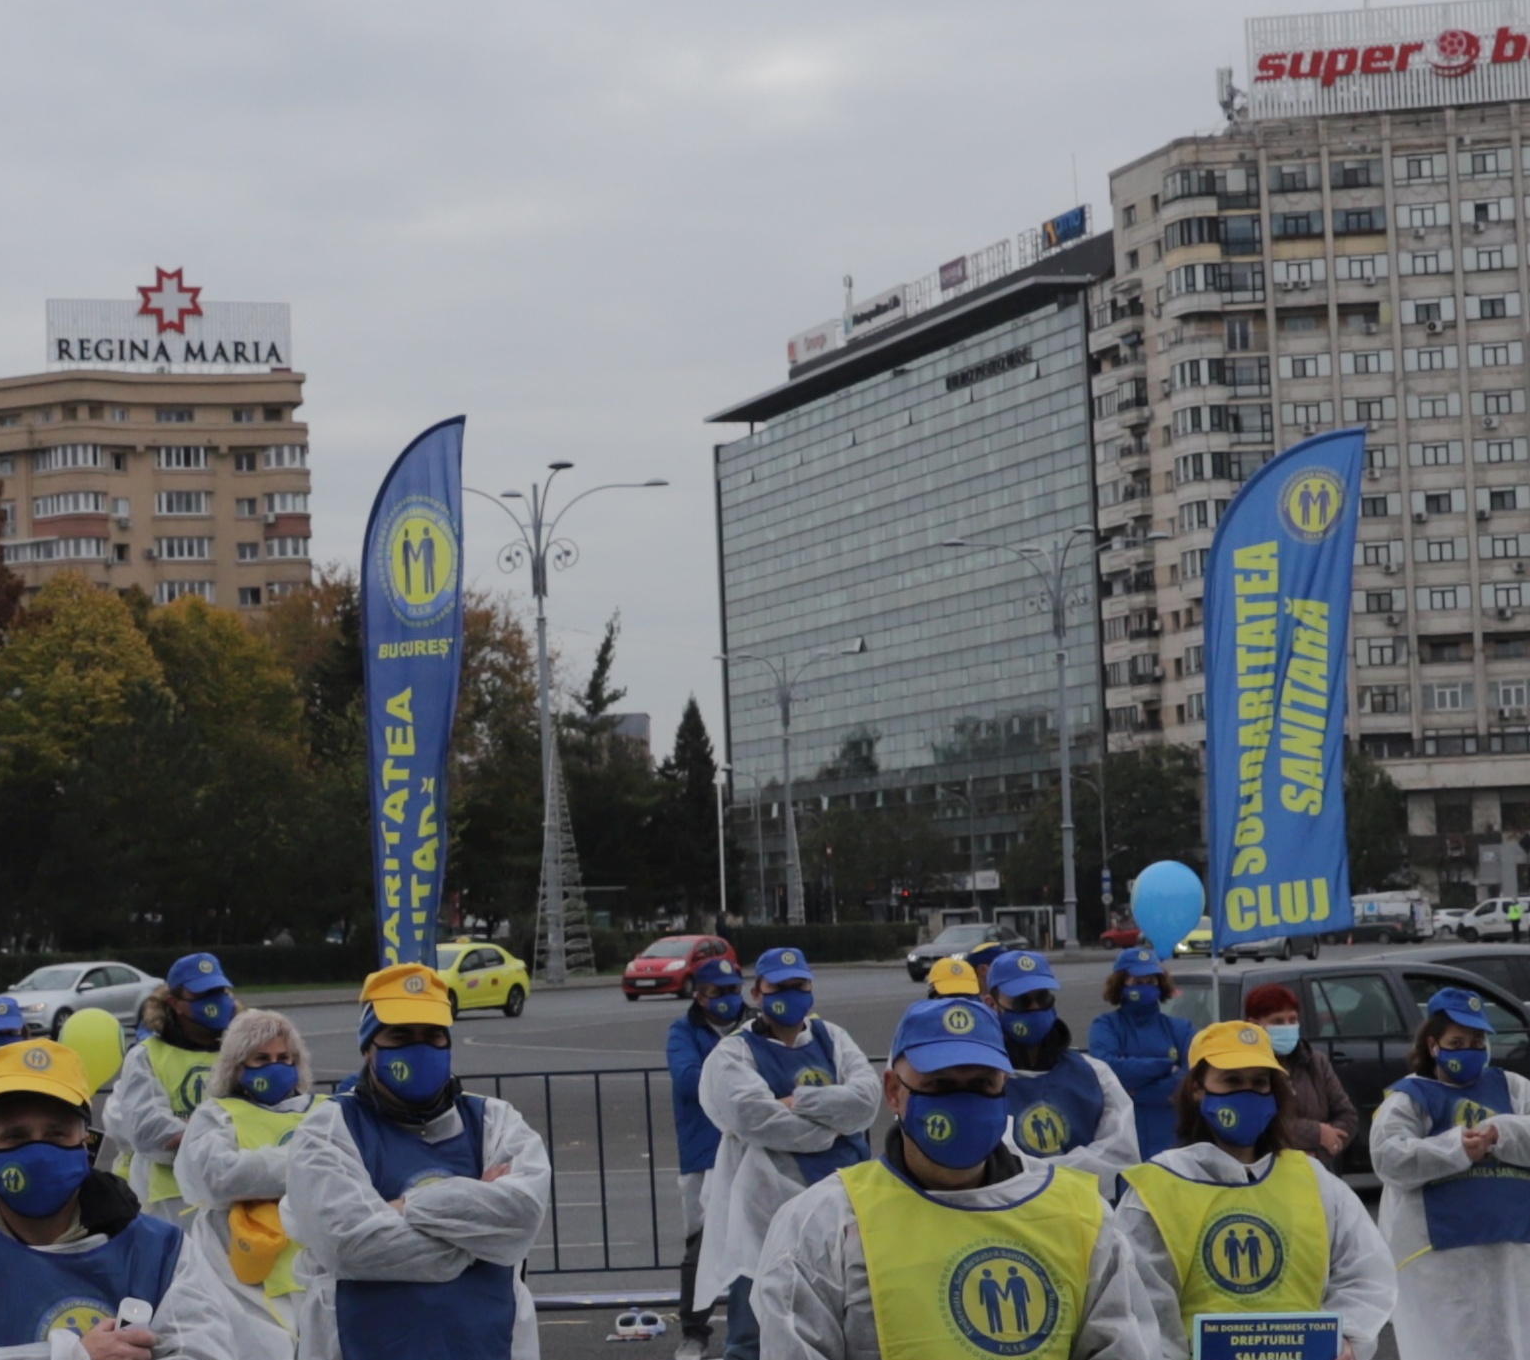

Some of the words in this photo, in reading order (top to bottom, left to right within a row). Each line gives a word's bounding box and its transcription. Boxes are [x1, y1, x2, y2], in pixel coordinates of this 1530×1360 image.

[1253, 41, 1424, 88] super
[57, 338, 172, 362] REGINA
[183, 341, 283, 364] MARIA
[378, 637, 454, 660] BUCUREȘ
[1231, 540, 1279, 877] SOLIDARITATEA
[1280, 597, 1330, 816] SANITARĂ
[1225, 877, 1330, 933] CLUJ
[1221, 1323, 1255, 1333] DORESC
[1256, 1322, 1268, 1332] SĂ
[1269, 1322, 1307, 1332] PRIMESC
[1308, 1322, 1337, 1331] TOATE
[1230, 1334, 1305, 1346] DREPTURILE
